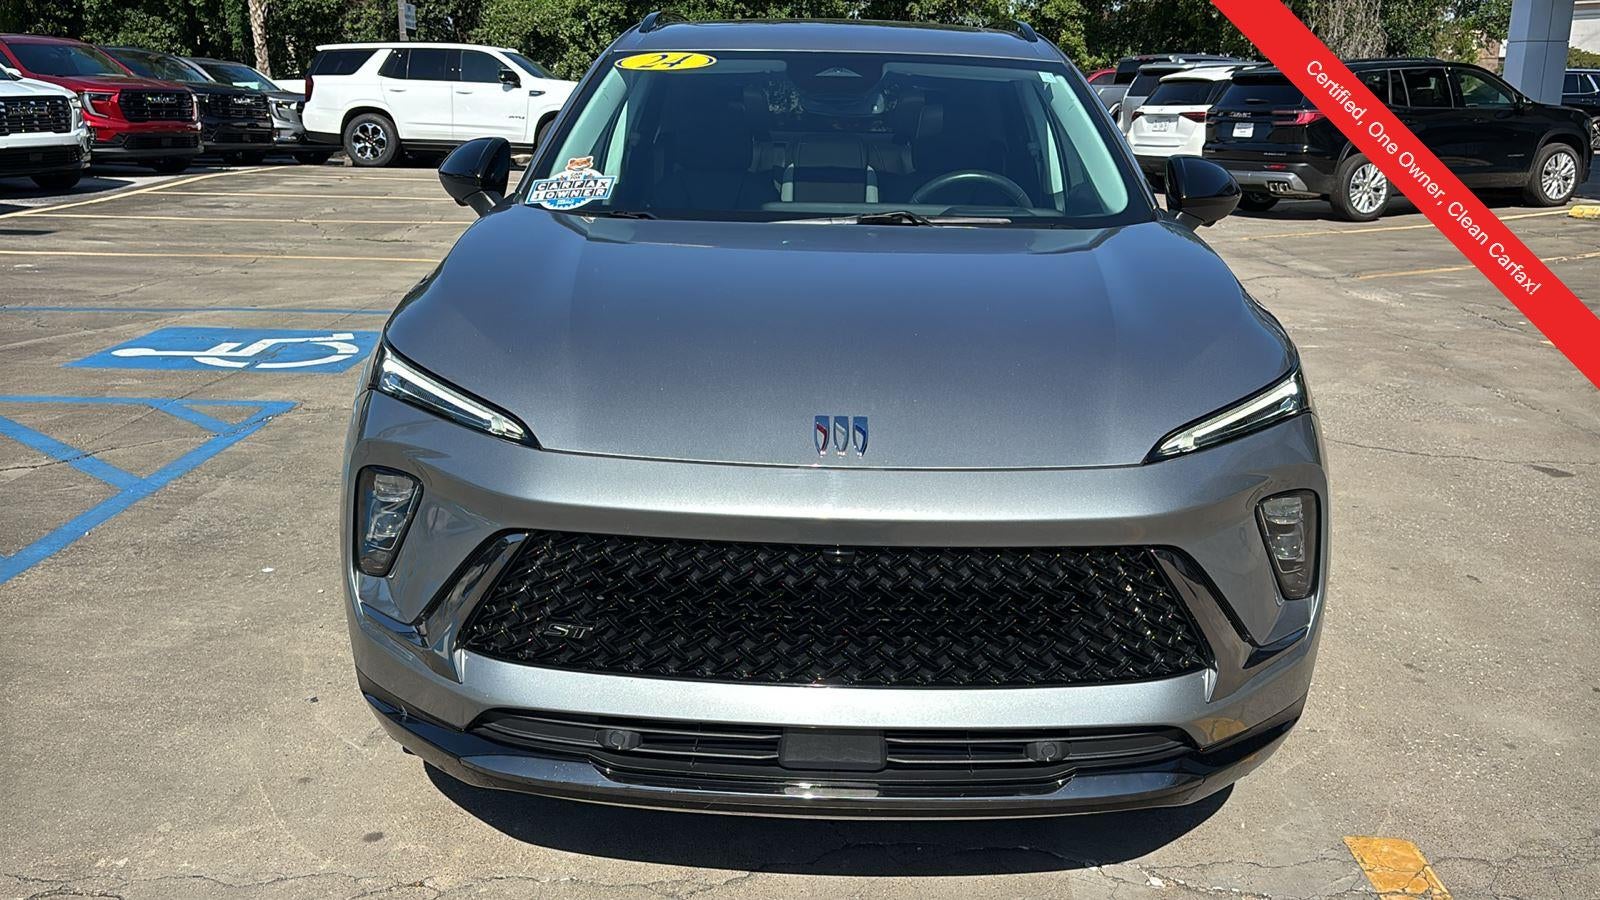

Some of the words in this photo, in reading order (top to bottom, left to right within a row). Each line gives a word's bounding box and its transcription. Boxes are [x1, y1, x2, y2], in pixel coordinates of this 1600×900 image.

[637, 54, 694, 68] 24
[536, 179, 608, 191] CARFAX
[545, 188, 607, 199] OWNER
[543, 623, 593, 639] ST
